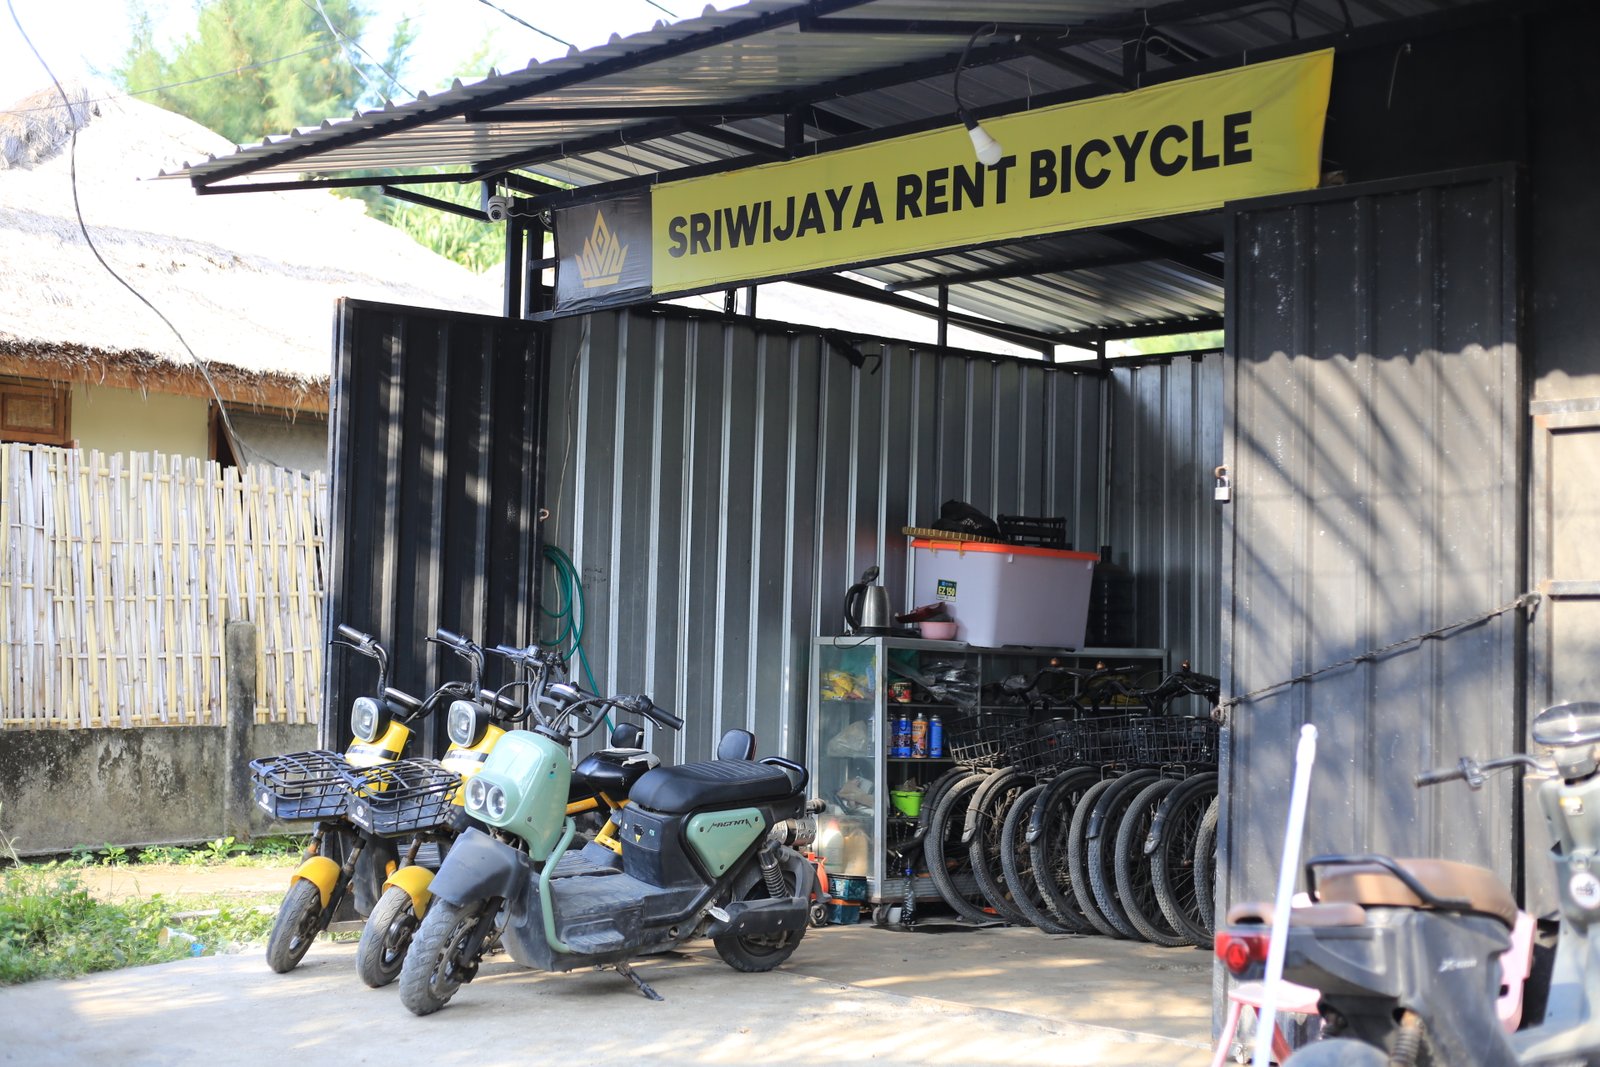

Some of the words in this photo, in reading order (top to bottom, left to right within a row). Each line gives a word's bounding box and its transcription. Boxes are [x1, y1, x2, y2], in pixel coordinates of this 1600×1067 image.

[668, 181, 884, 258] SRIWIJAYA
[896, 154, 1017, 220] RENT
[1029, 111, 1253, 199] BICYCLE
[938, 586, 946, 595] EZ
[946, 587, 956, 597] 150
